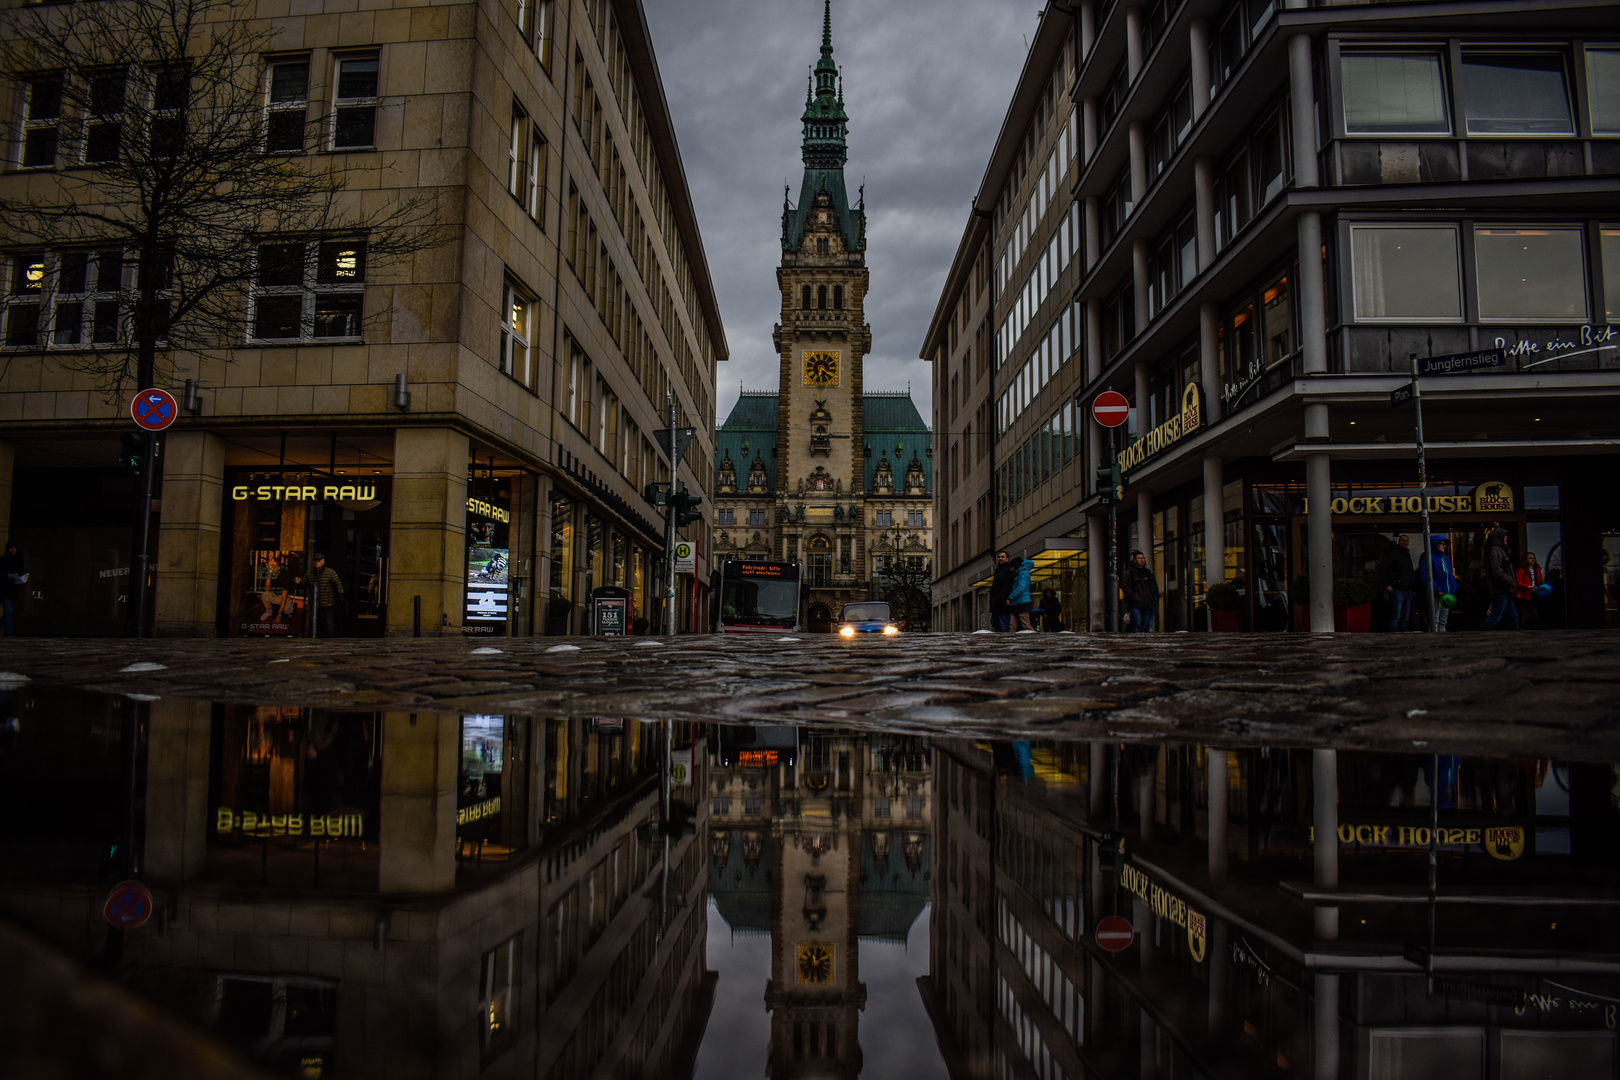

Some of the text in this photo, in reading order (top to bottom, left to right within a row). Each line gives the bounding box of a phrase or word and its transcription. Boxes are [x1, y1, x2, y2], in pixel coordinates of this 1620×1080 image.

[1546, 338, 1576, 351] ein
[1580, 325, 1619, 346] Bit
[1423, 352, 1500, 373] Jungfernstieg
[1183, 405, 1198, 423] BLOCK
[1183, 417, 1199, 433] HOUSE
[1117, 413, 1182, 474] BLOCK HOUSE
[232, 485, 376, 501] G-STAR RAW
[1302, 495, 1472, 514] OCK HOUSE
[492, 505, 510, 524] RAW
[679, 546, 687, 555] H
[99, 567, 131, 578] NEUER
[271, 623, 290, 631] RAW
